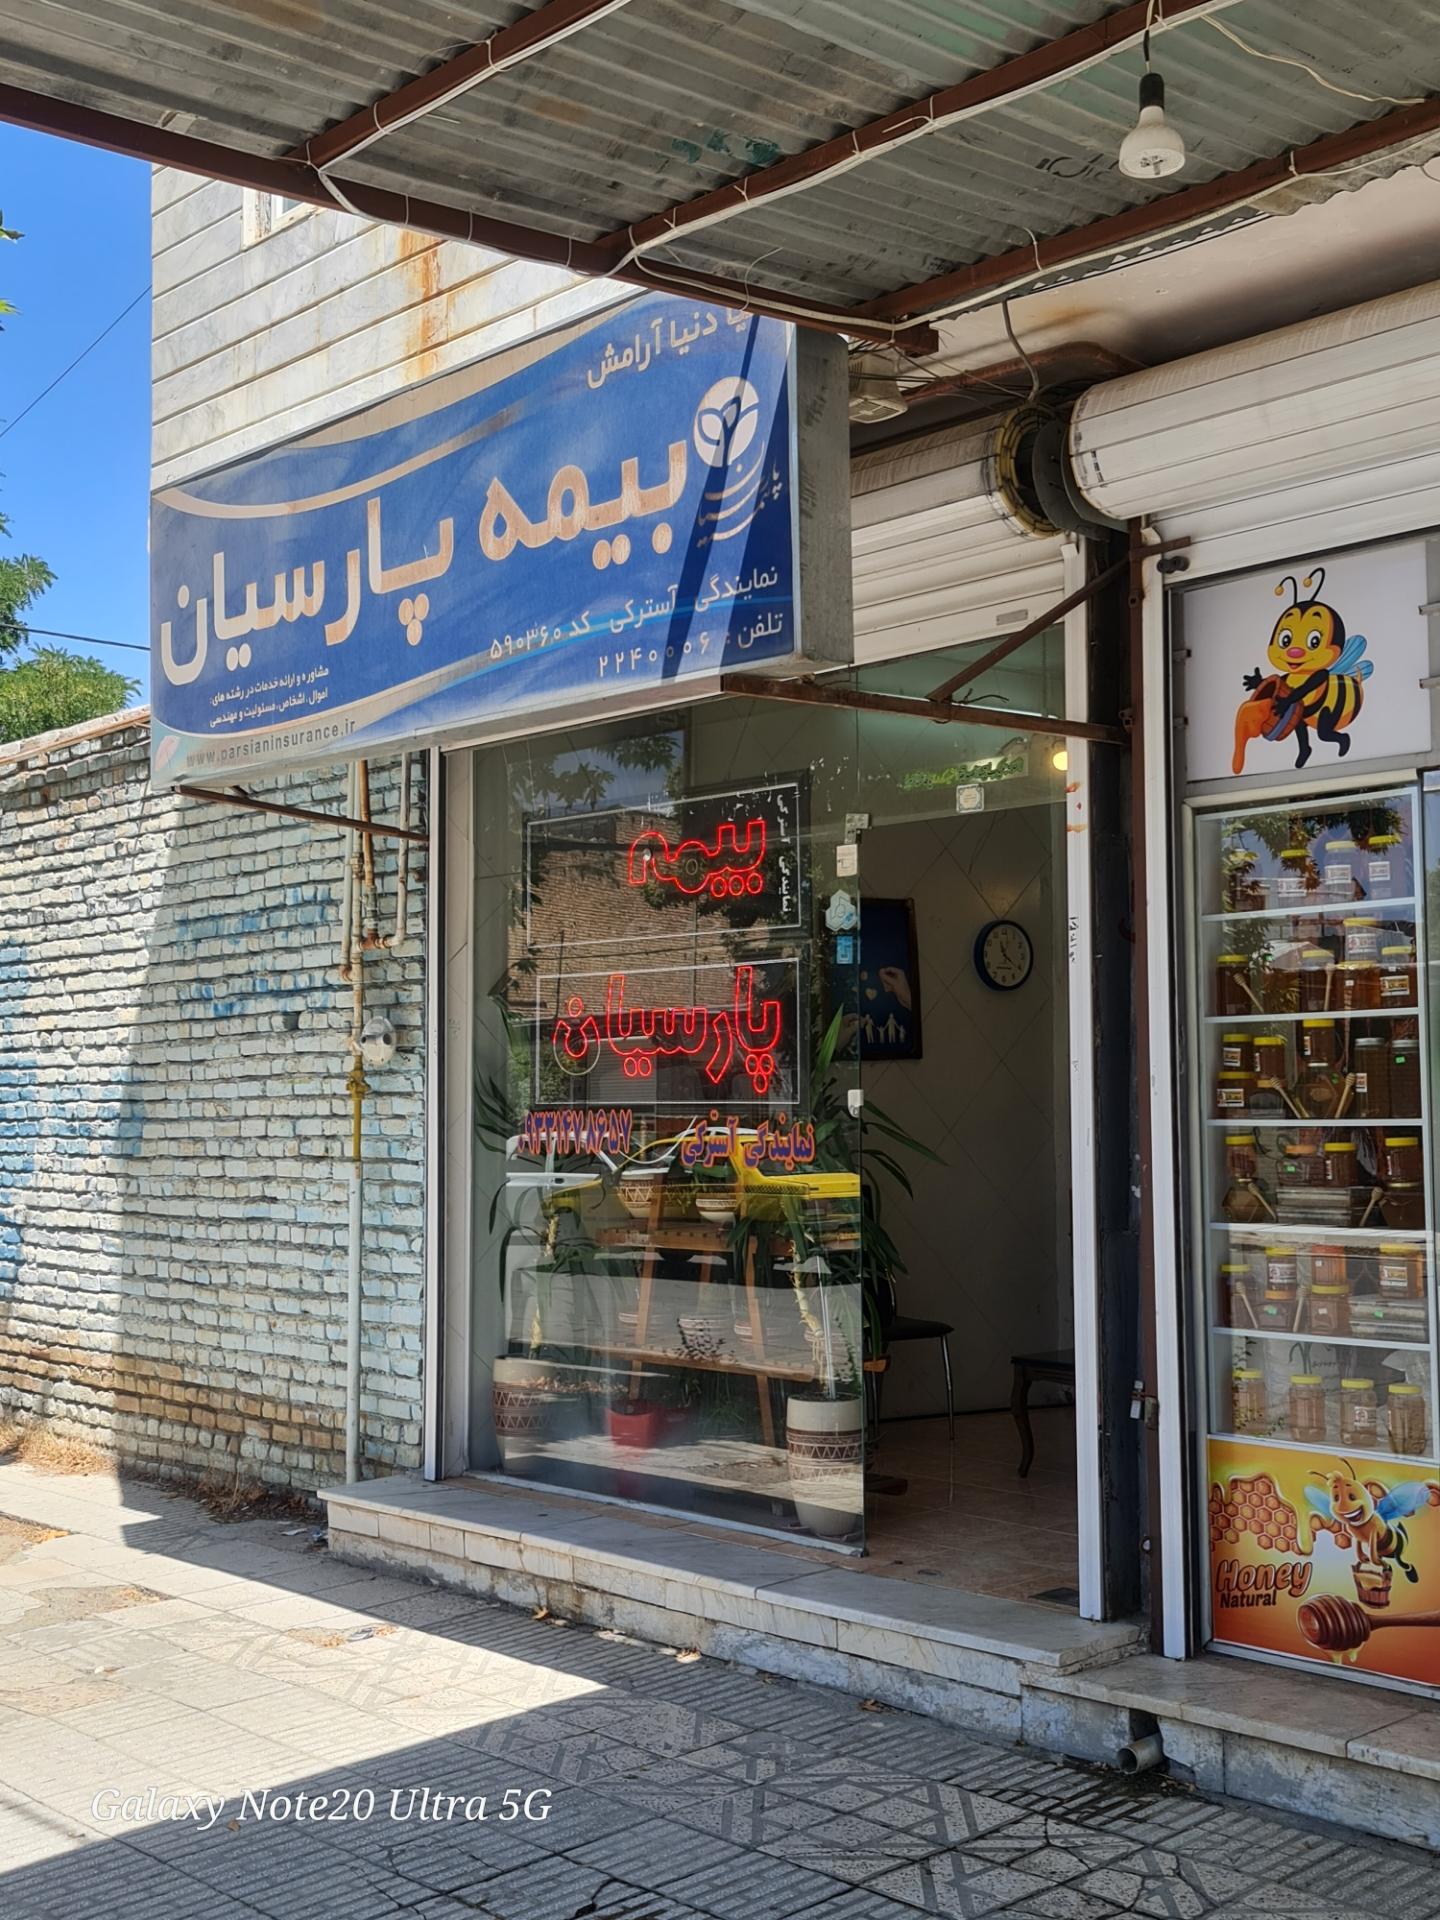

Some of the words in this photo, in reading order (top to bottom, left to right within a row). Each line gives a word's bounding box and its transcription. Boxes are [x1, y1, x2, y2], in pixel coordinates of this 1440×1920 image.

[586, 317, 663, 389] آرامش
[670, 311, 718, 356] دنیا
[478, 440, 688, 571] بیمه
[160, 496, 454, 686] پارسیان
[609, 584, 679, 634] آسترکی
[694, 566, 778, 612] نمایندگی
[490, 622, 561, 660] ۵۹۰۳۶۰
[569, 610, 590, 637] کد
[185, 717, 356, 769] www.parsianinsurance.ir
[552, 965, 782, 1095] پارسیان
[744, 1111, 816, 1172] نمایندگی
[1215, 1558, 1313, 1598] Honey
[1219, 1590, 1277, 1608] Natural
